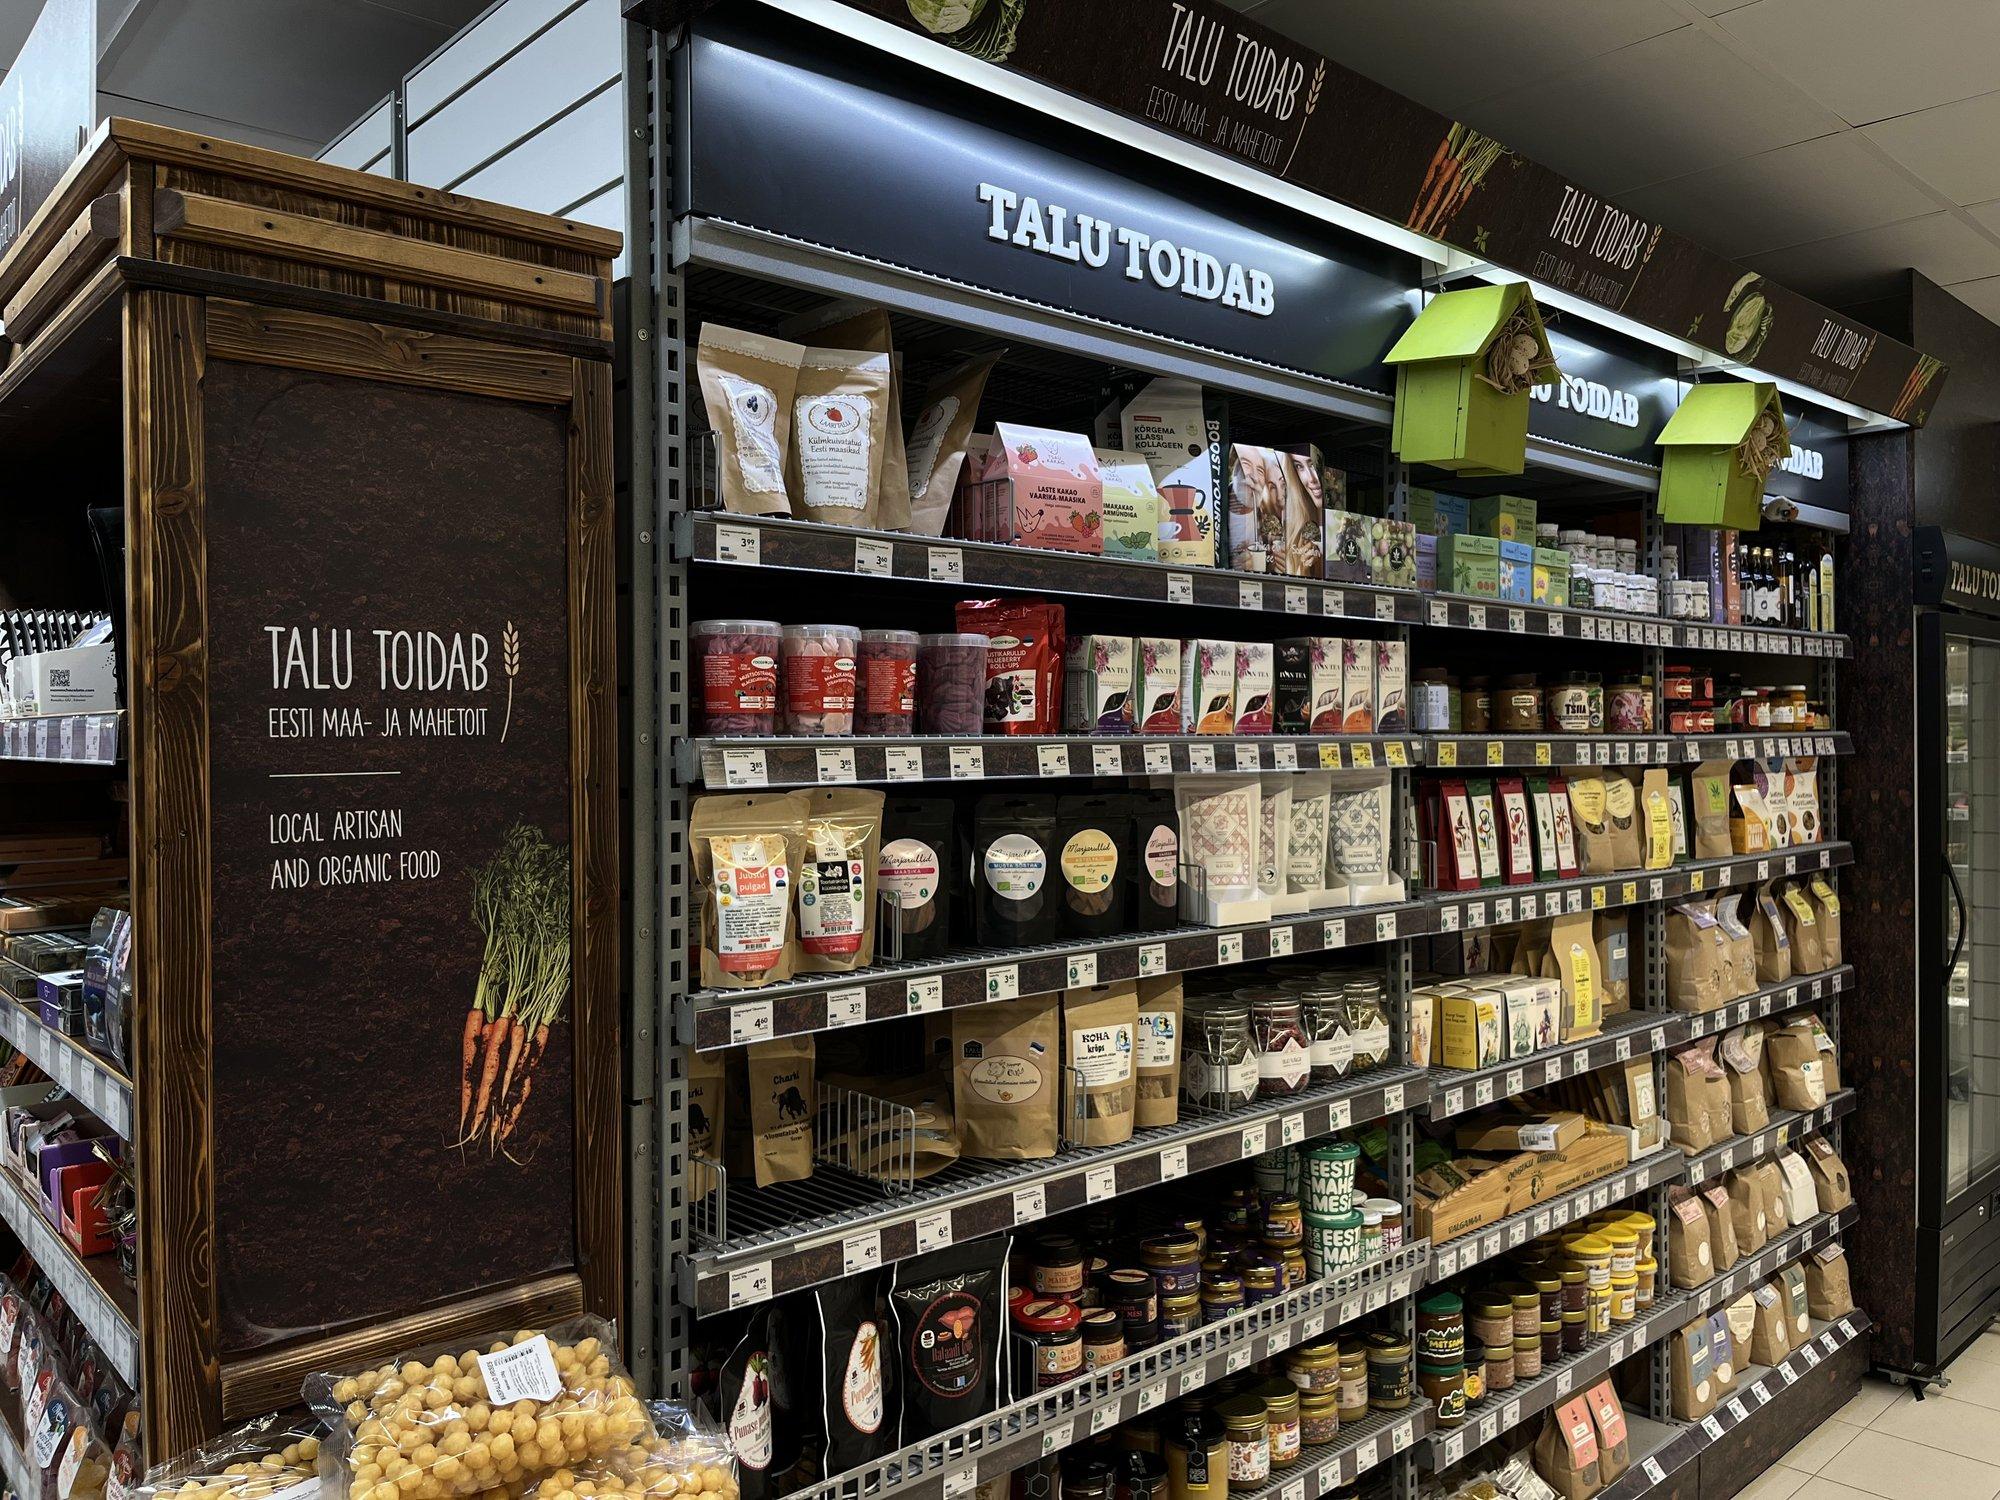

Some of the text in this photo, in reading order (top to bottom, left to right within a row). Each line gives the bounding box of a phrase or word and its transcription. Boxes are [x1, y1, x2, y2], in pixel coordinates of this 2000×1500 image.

[1161, 2, 1304, 121] TALU TOIDAB
[1145, 86, 1284, 167] EESTI MAA- JA MAHETOIT
[1550, 185, 1648, 271] TALU TOIDAB
[979, 182, 1275, 317] TALU TOIDAB
[1811, 318, 1868, 371] TALU TOIDAB
[1558, 372, 1639, 428] TOIDAB
[1134, 425, 1175, 434] KÕRGEMA
[829, 446, 860, 455] maasikad
[1135, 441, 1183, 449] KOLLAGEEN
[1206, 420, 1220, 477] BOOST
[1029, 492, 1086, 504] VAARIKA-MAASIKA
[1037, 486, 1078, 496] LASTE KAKAO
[1103, 503, 1134, 511] IMAKAKAO
[1103, 509, 1138, 518] ARMÜNDIGA
[1951, 560, 1980, 596] TALU
[264, 625, 489, 691] TALU TOIDAB
[987, 650, 1027, 658] USTIKARULLID
[269, 708, 488, 738] EESTI MAA- JA MAHETOIT
[270, 808, 402, 844] LOCAL ARTISAN
[1067, 843, 1111, 855] Marjarullid
[880, 852, 932, 867] Marjarullid
[271, 850, 441, 890] AND ORGANIC FOOD
[740, 882, 766, 892] pulgad
[1082, 1032, 1110, 1043] KOHA
[773, 1071, 800, 1085] Charki
[1310, 1158, 1355, 1177] EESTI
[1311, 1176, 1354, 1194] MAHE
[1312, 1195, 1351, 1213] MESI
[1323, 1228, 1361, 1247] EEST
[864, 1246, 877, 1257] 495
[1324, 1245, 1360, 1264] MAH
[753, 1277, 767, 1289] 495
